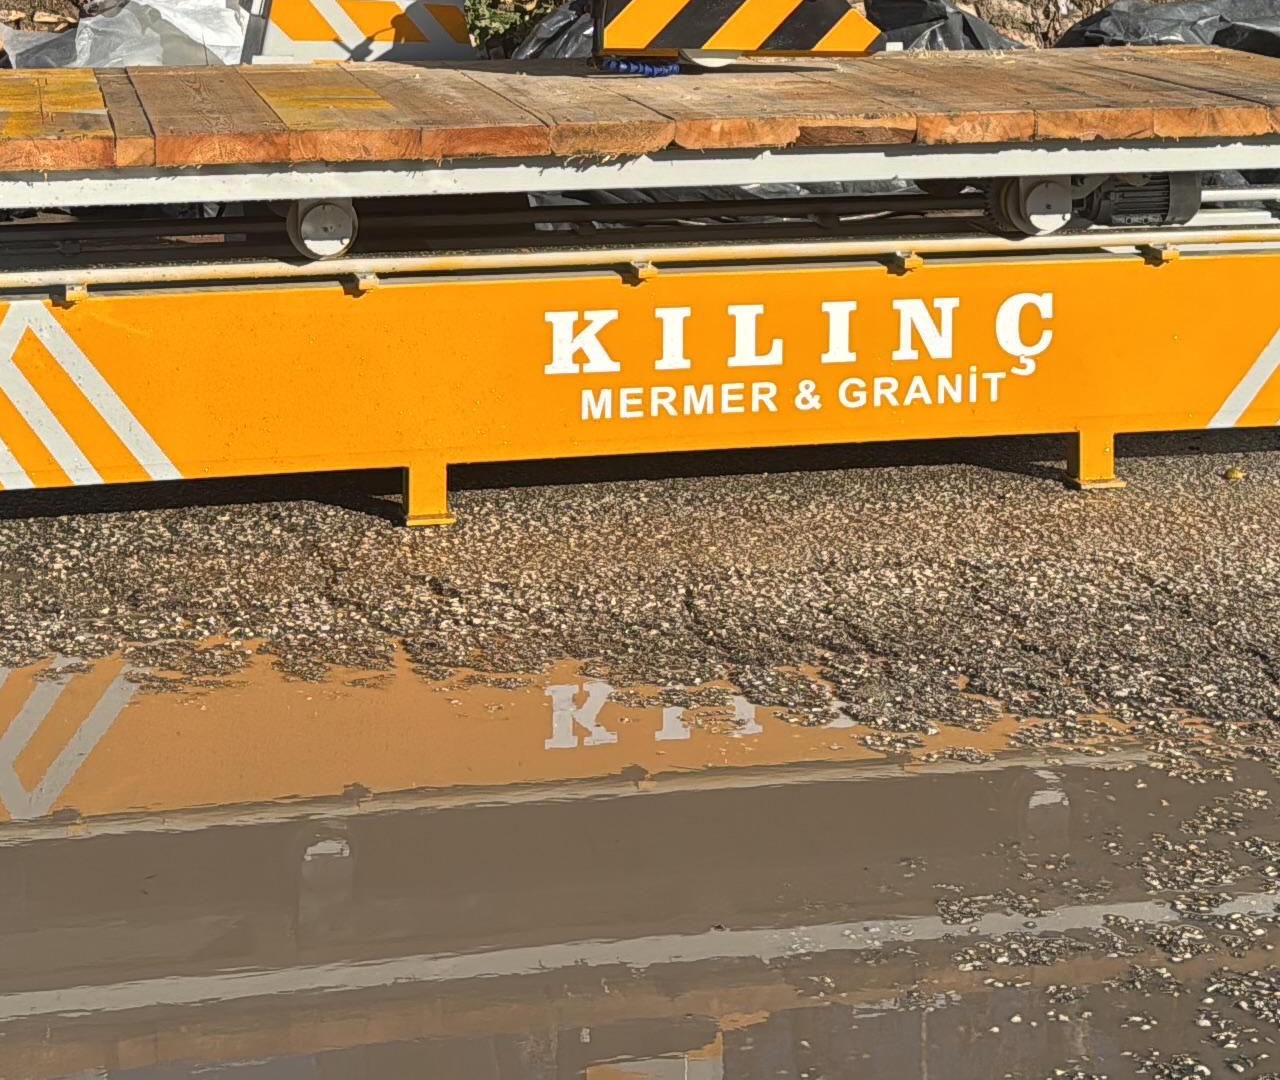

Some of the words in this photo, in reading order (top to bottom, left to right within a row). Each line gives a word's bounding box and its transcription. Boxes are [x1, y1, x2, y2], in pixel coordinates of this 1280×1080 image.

[544, 291, 1054, 376] KILINÇ
[580, 382, 778, 420] MERMER
[794, 380, 822, 411] &
[837, 364, 1007, 408] GRANİT
